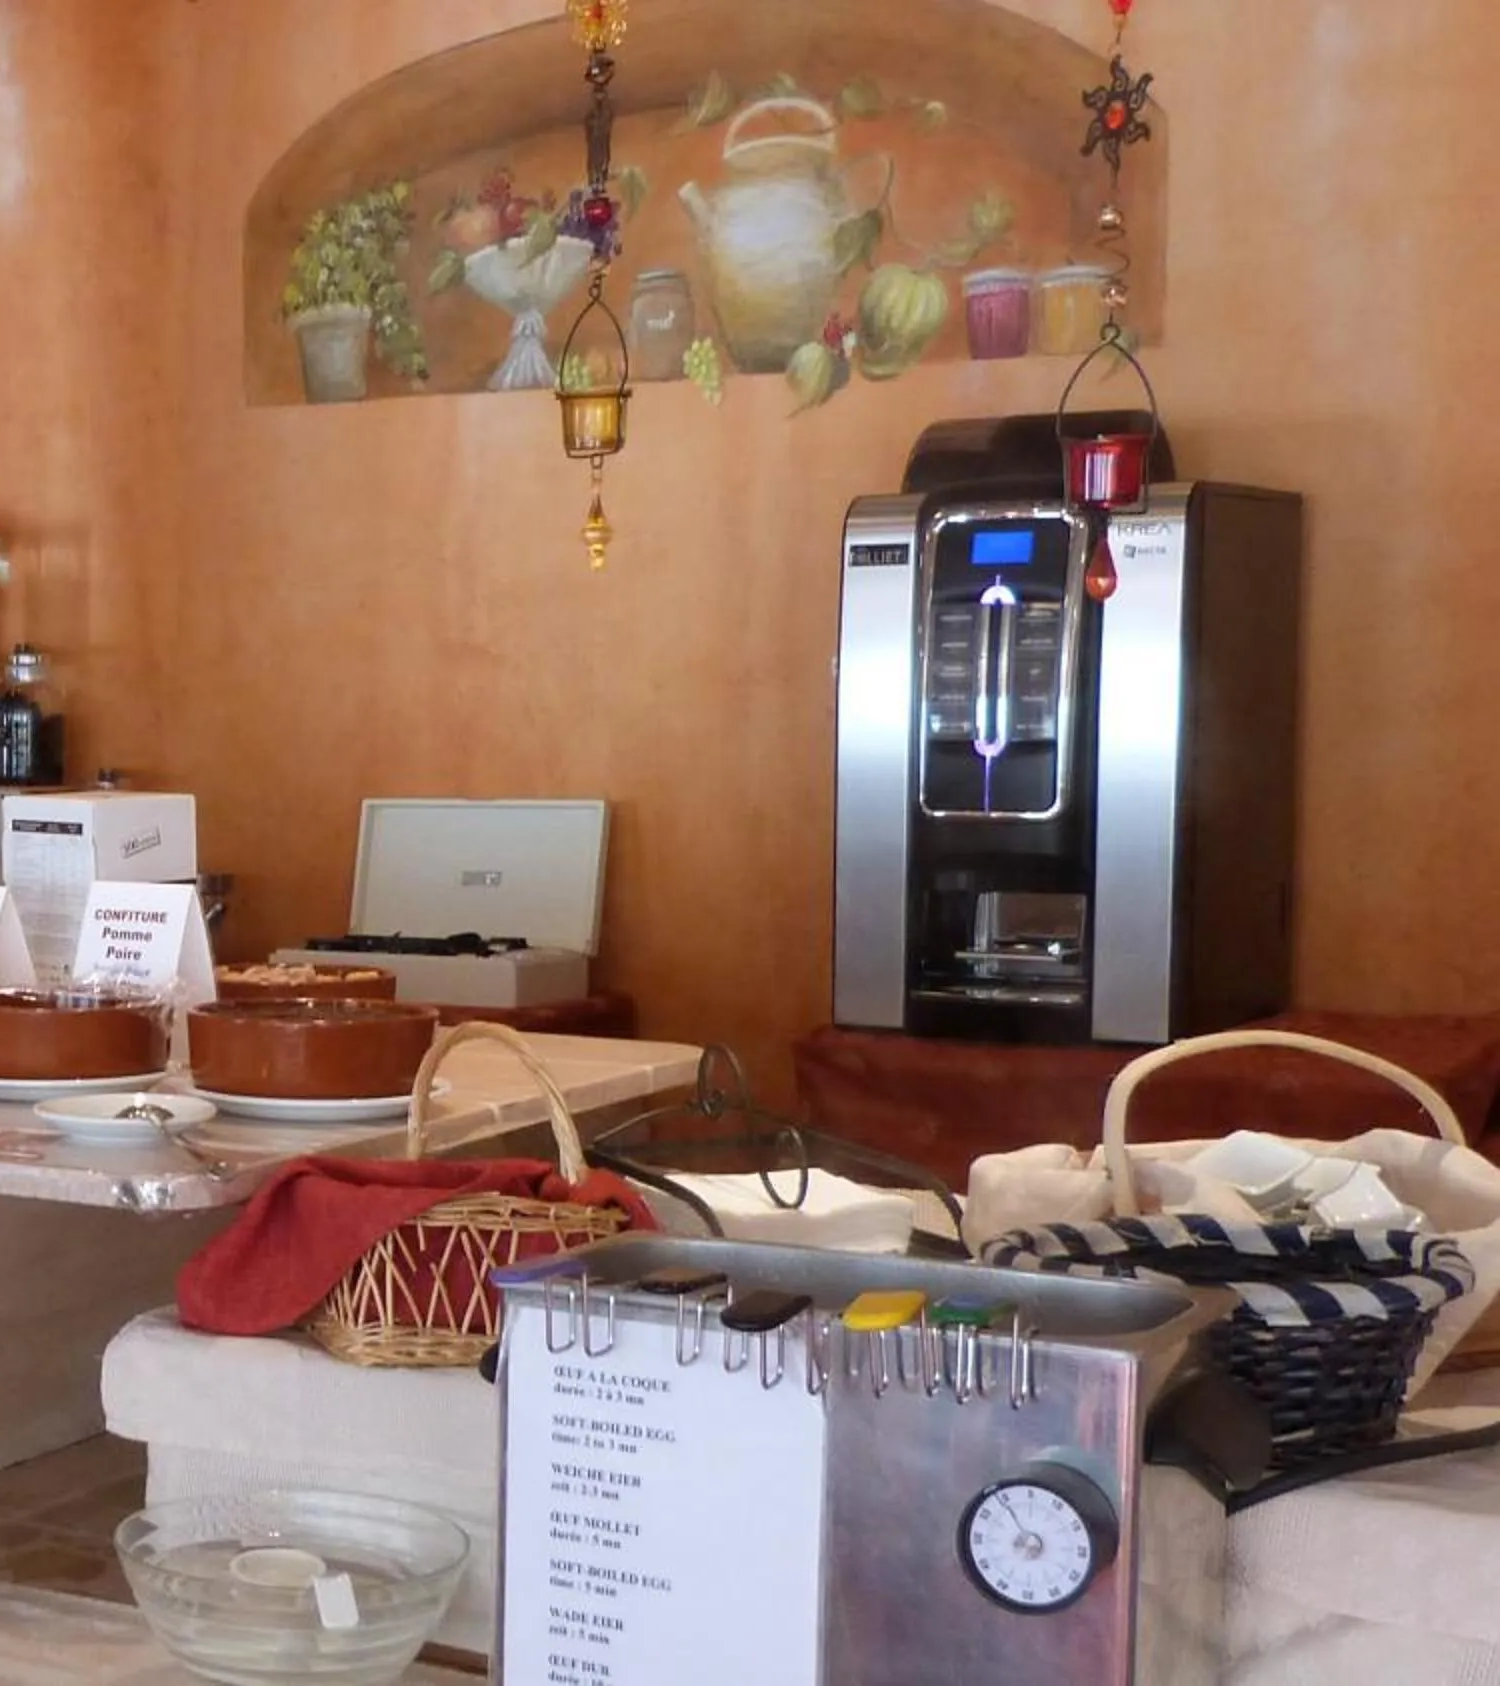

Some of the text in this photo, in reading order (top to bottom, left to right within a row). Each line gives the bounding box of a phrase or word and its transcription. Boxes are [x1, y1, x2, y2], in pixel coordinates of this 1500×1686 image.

[94, 908, 168, 923] CONFITURE
[102, 926, 153, 942] Pomme
[106, 945, 142, 961] Poire
[600, 1372, 618, 1387] LA
[621, 1375, 671, 1393] COQUE
[646, 1429, 676, 1443] EGG
[551, 1463, 642, 1488] WEICHE EIER
[583, 1515, 640, 1537] MOLLET
[641, 1577, 672, 1592] EGG
[549, 1605, 624, 1632] WADE EIER
[581, 1660, 611, 1677] DUR
